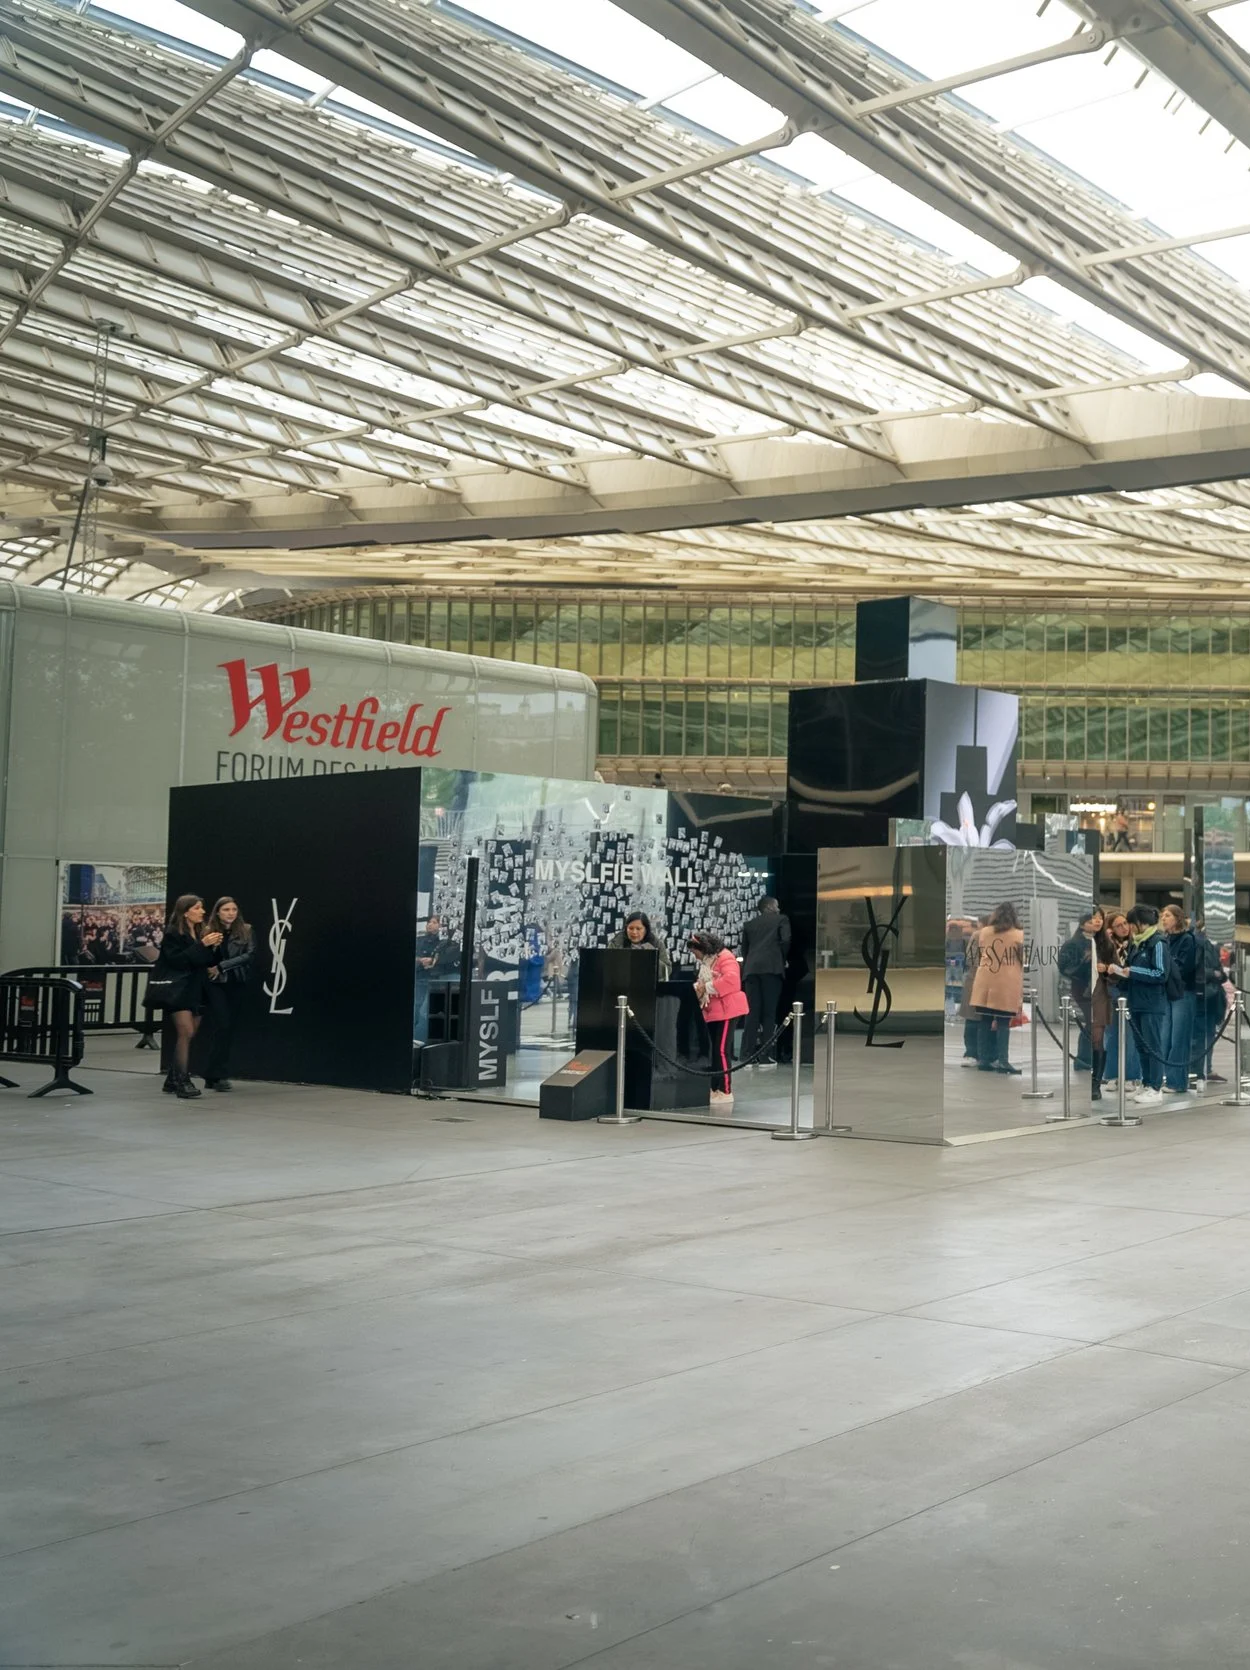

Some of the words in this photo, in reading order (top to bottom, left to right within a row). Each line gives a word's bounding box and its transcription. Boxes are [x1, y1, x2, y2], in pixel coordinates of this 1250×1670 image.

[217, 659, 452, 757] Westfield
[216, 751, 303, 782] FORUM
[535, 859, 633, 884] MYSLFIE
[641, 863, 699, 887] WALL
[478, 989, 500, 1081] MYSLF
